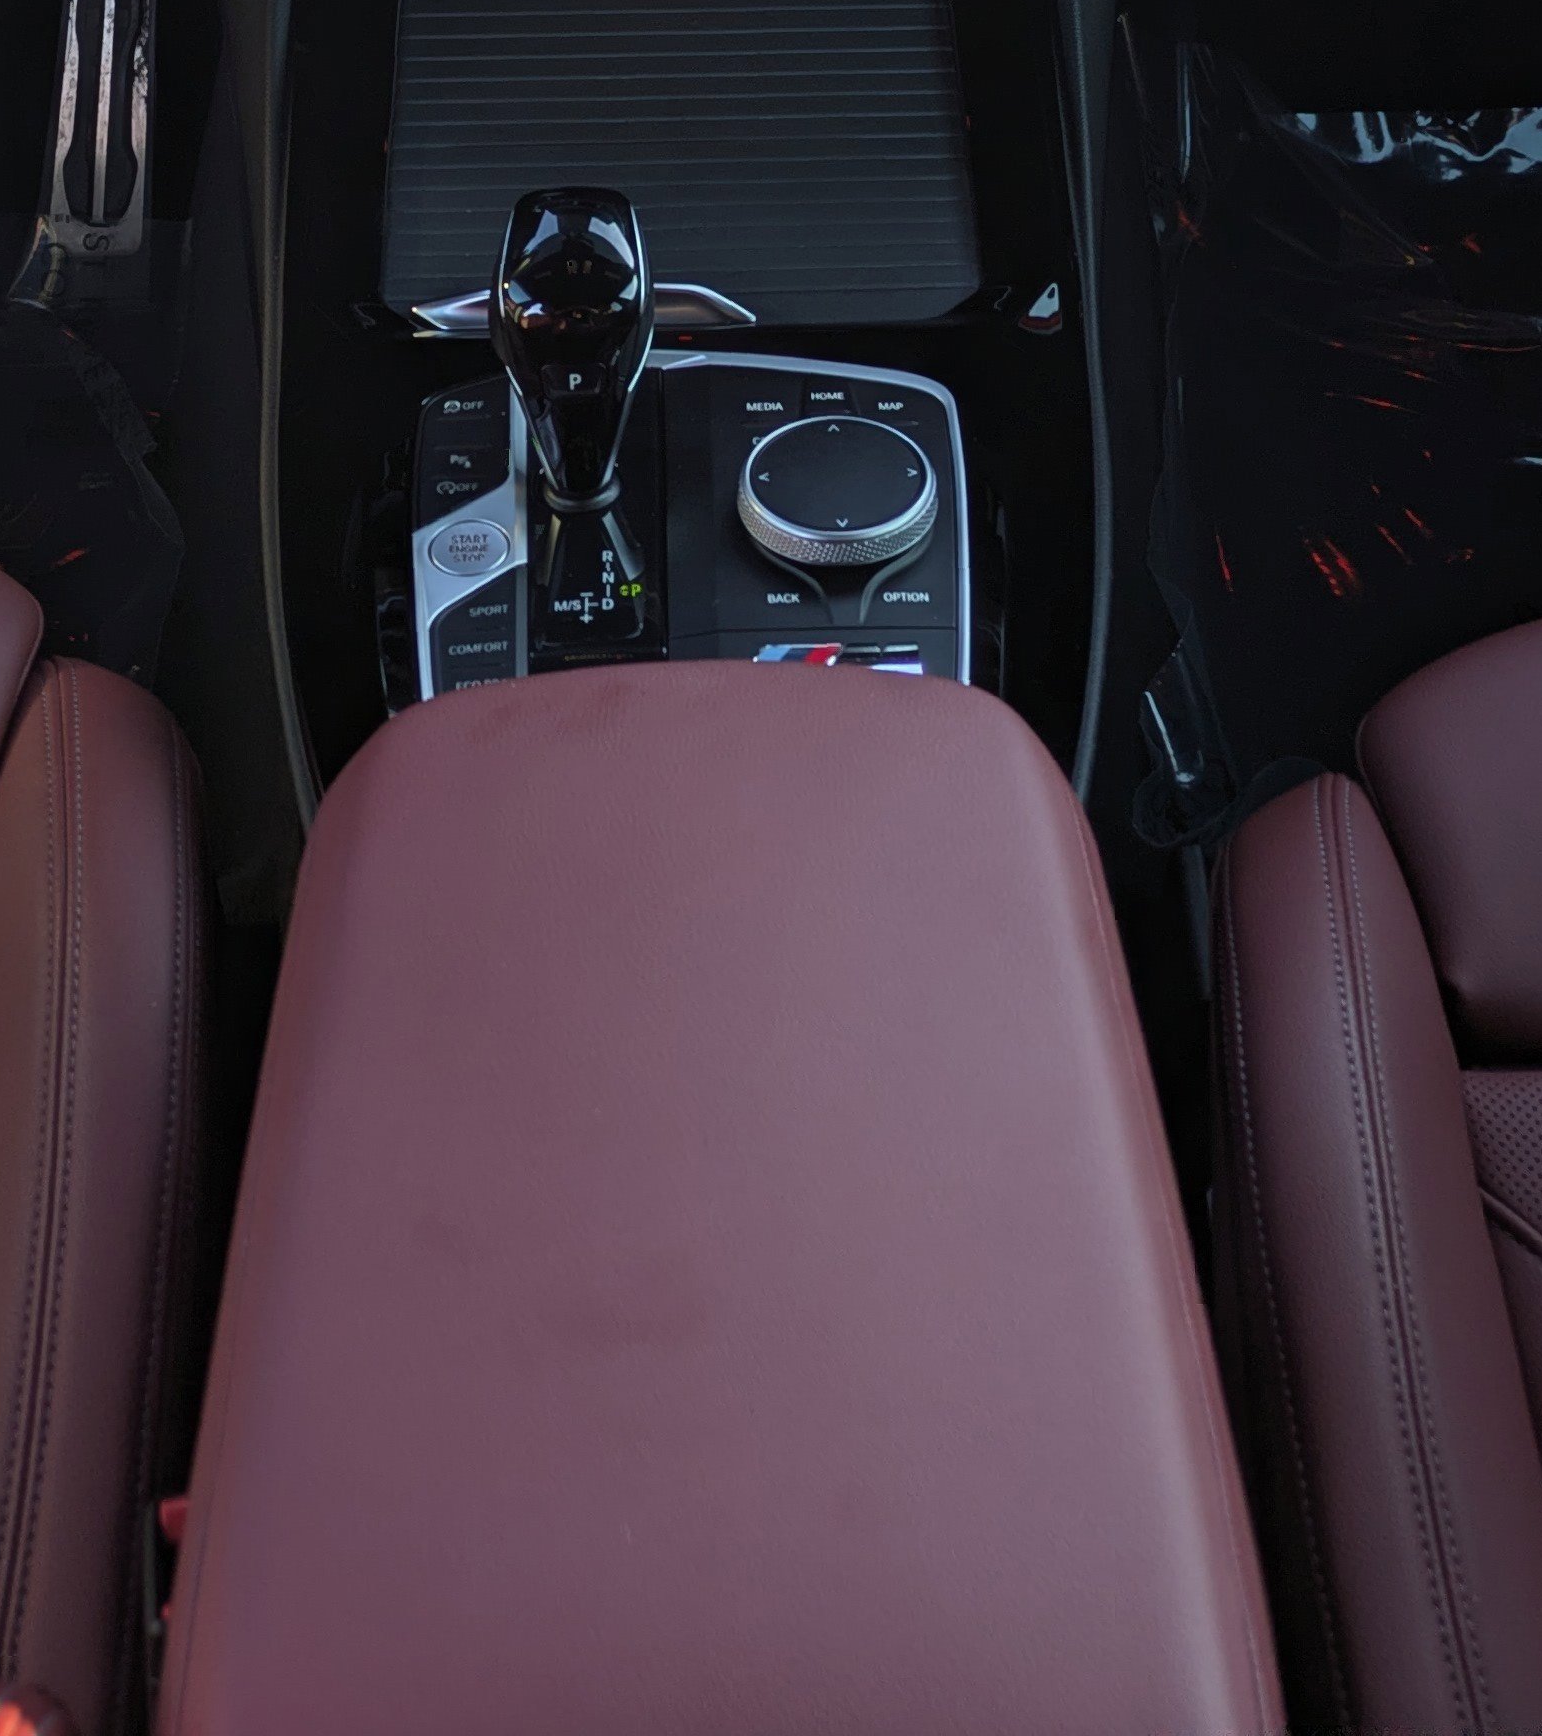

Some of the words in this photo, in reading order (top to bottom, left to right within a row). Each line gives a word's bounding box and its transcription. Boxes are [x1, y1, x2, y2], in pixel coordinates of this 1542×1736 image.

[569, 373, 582, 391] P
[810, 391, 844, 401] HOME
[462, 400, 484, 411] OFF
[746, 402, 784, 412] MEDIA
[877, 401, 904, 411] MAP
[450, 534, 488, 544] START
[448, 543, 489, 554] ENGINE
[452, 553, 486, 563] STOP
[602, 550, 614, 563] R
[602, 571, 615, 584] N
[767, 593, 800, 604] BACK
[883, 591, 930, 603] OPTION
[553, 599, 582, 612] M/S
[601, 597, 615, 611] D
[469, 603, 508, 618] SPORT
[448, 640, 508, 656] COMFORT
